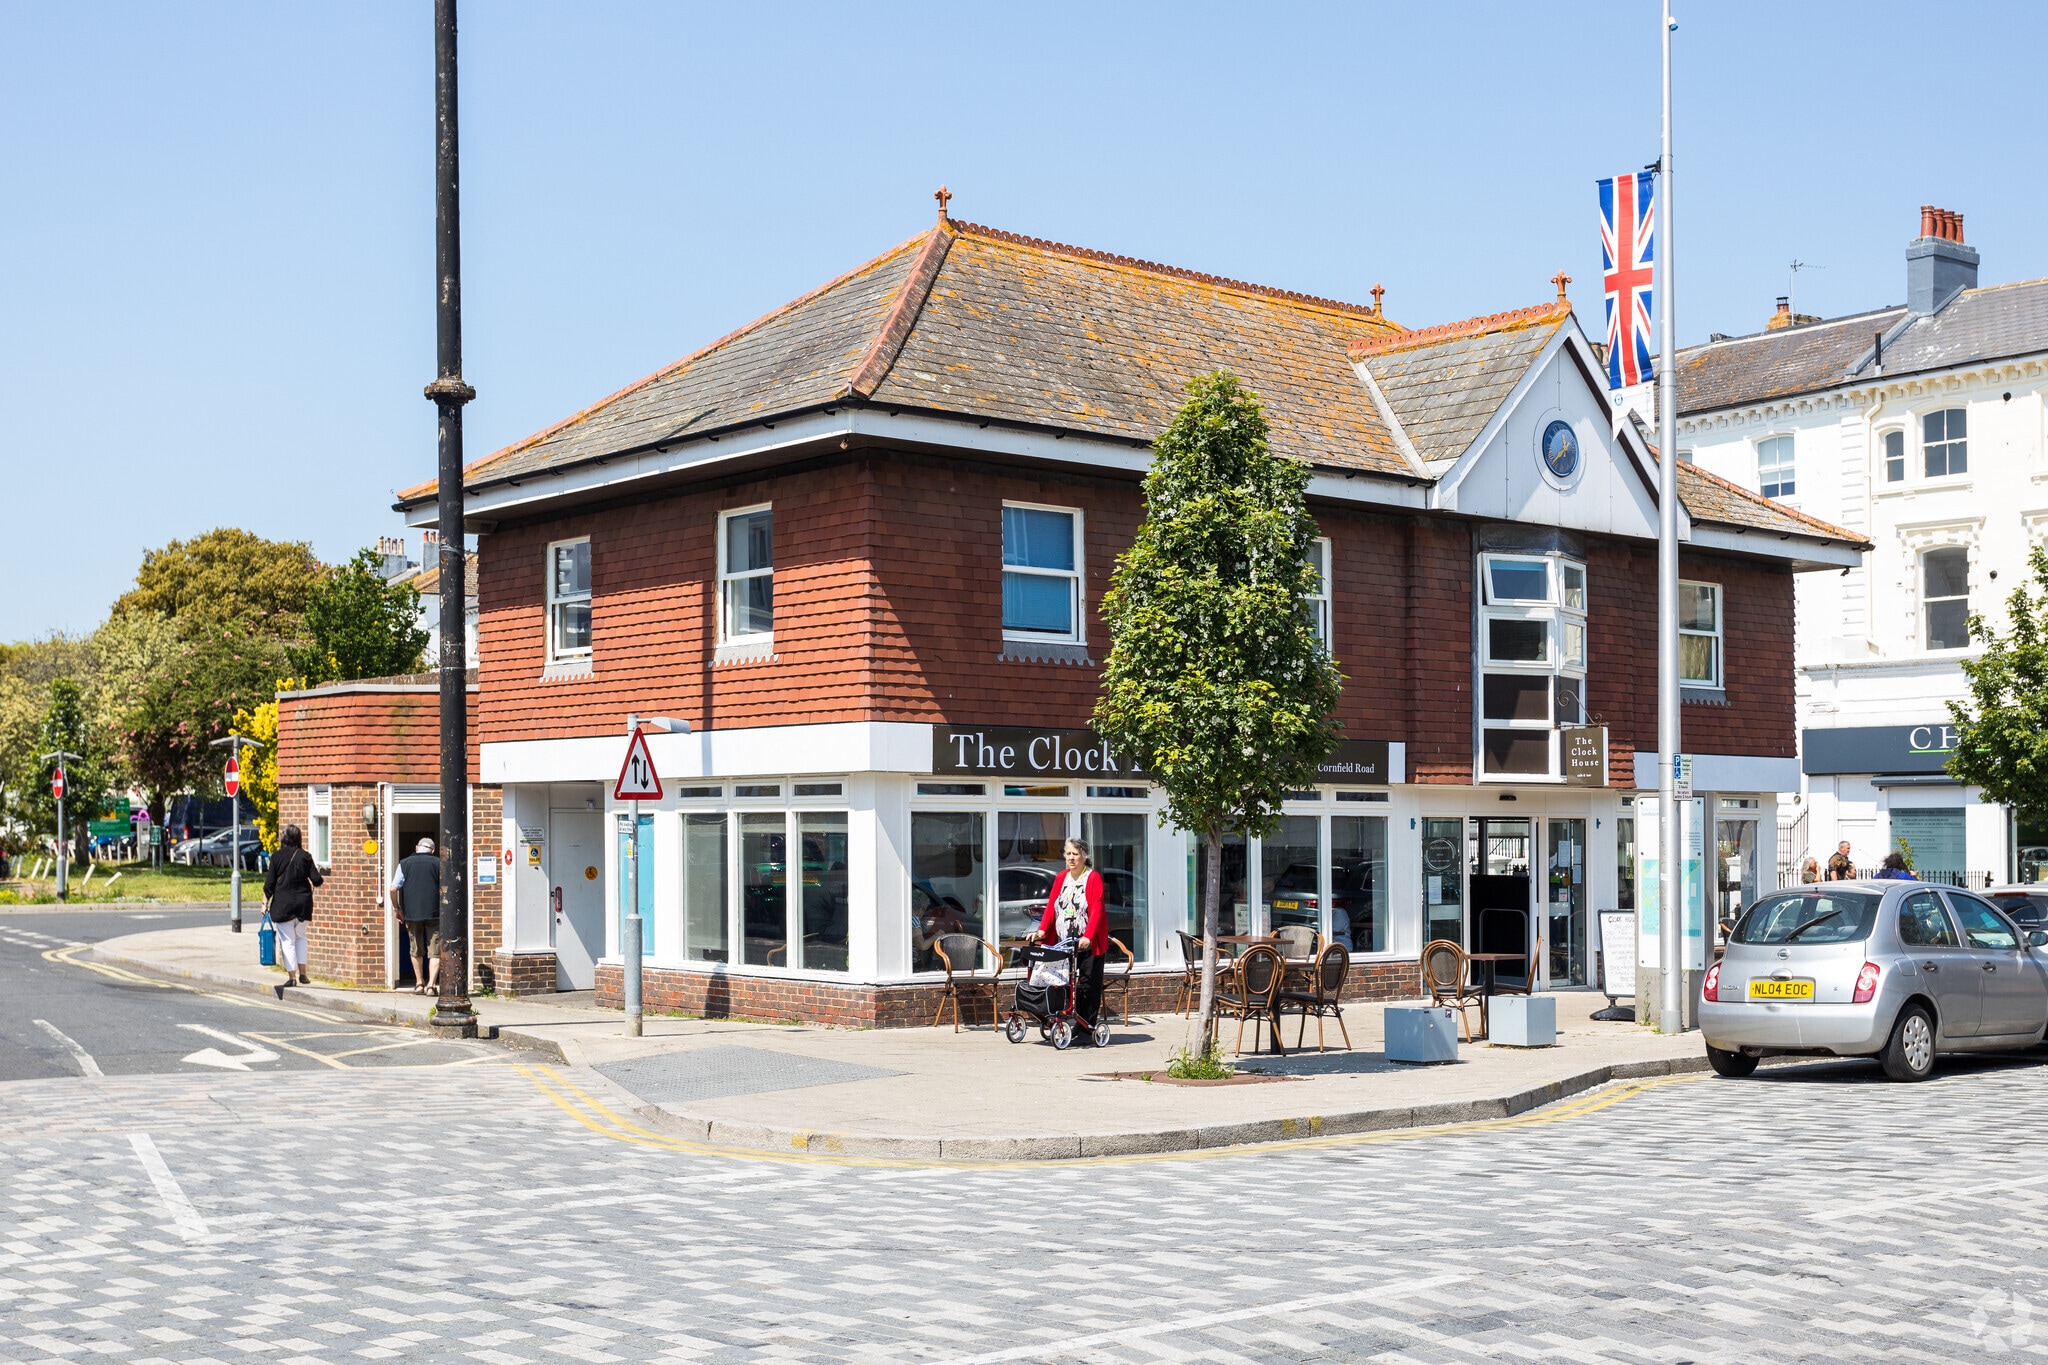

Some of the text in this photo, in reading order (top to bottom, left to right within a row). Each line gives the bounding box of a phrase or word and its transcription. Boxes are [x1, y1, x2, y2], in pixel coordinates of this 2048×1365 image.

[1575, 737, 1593, 745] The
[950, 732, 1119, 772] The Clock
[1571, 746, 1597, 756] Clock
[1317, 762, 1375, 774] Cornfield Road
[1571, 758, 1600, 767] House
[1754, 983, 1808, 996] NL04 EOC
